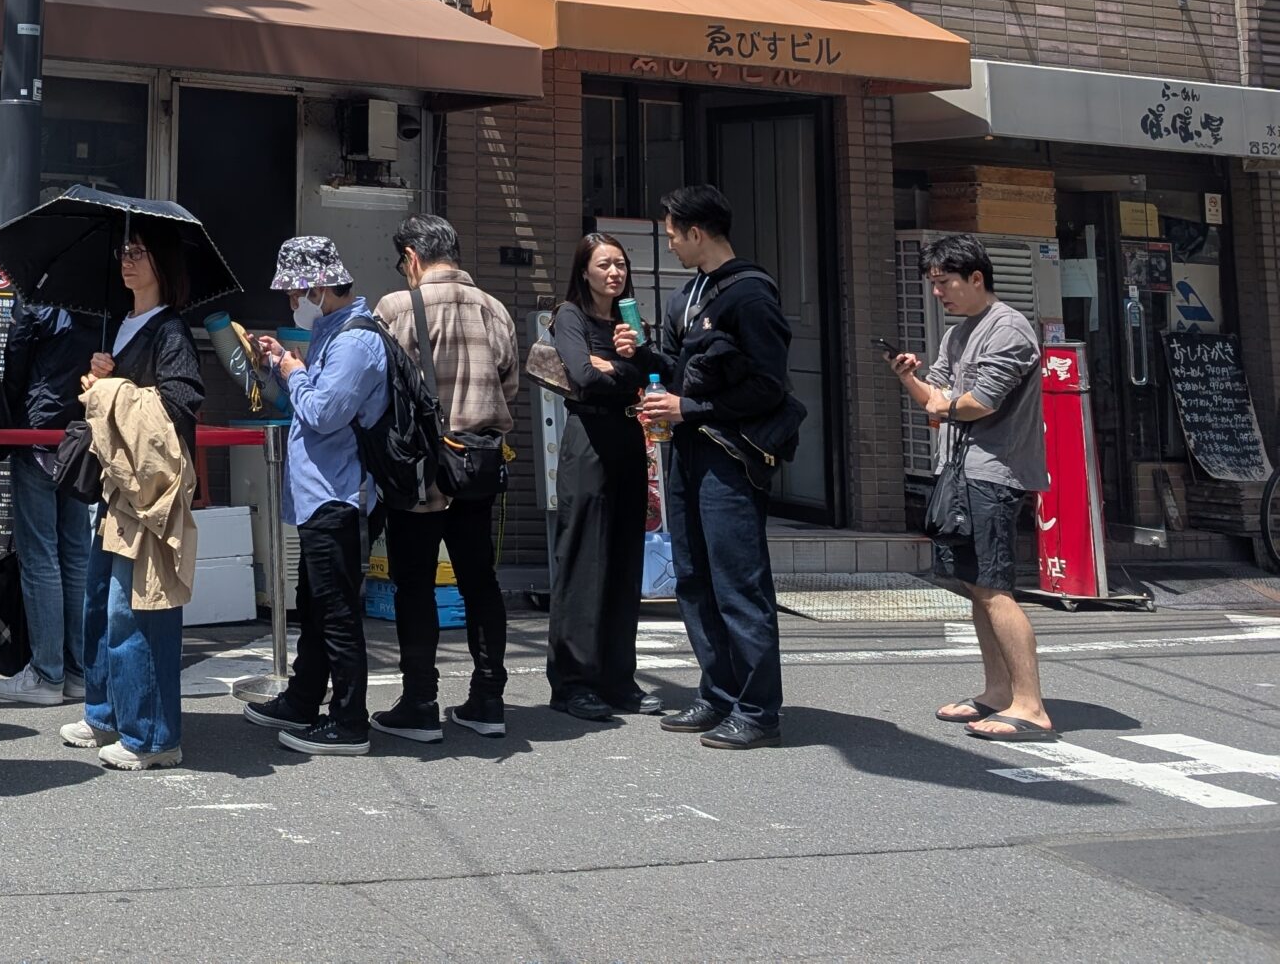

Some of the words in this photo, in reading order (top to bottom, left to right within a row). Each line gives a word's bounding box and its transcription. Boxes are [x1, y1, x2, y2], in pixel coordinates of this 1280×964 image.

[704, 24, 841, 66] ゑびすビル
[1161, 83, 1200, 102] らーめん
[1169, 338, 1235, 365] おしながき
[1209, 381, 1232, 391] 990円
